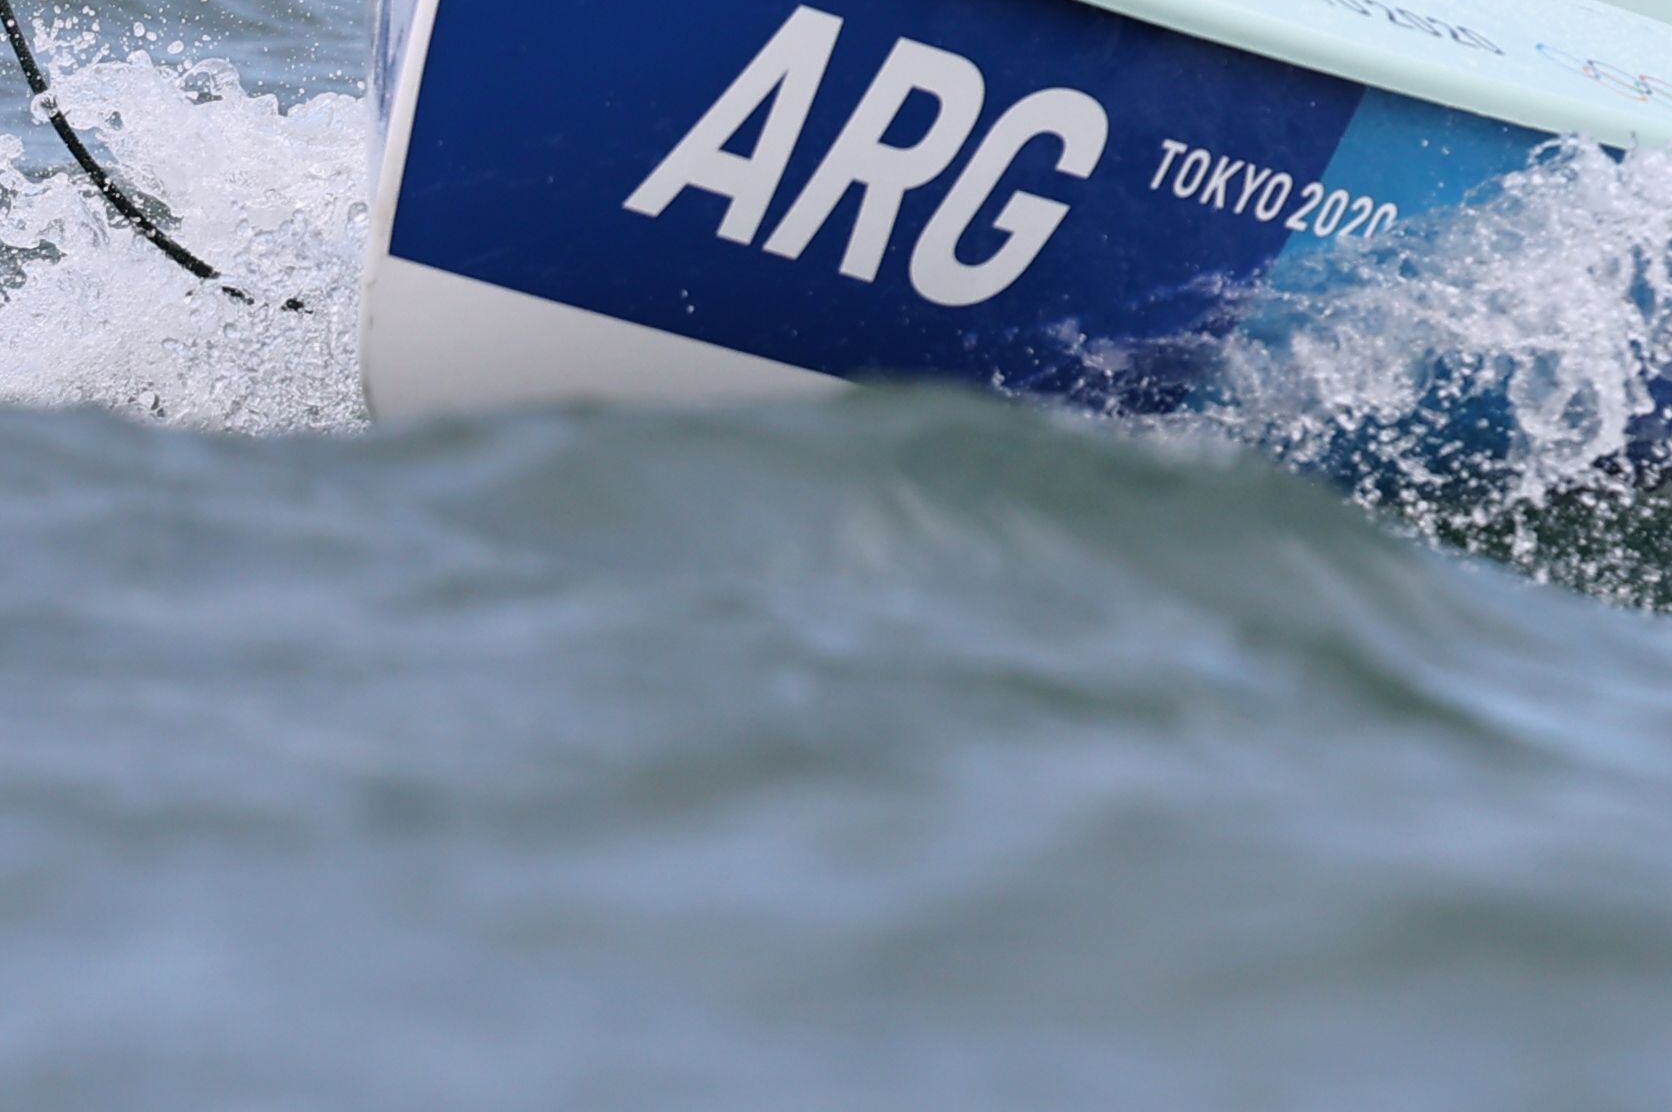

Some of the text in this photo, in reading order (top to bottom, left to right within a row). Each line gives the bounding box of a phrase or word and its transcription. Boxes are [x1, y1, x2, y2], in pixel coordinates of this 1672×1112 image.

[622, 4, 1109, 307] ARG
[1150, 138, 1398, 239] TOKYO 2020
